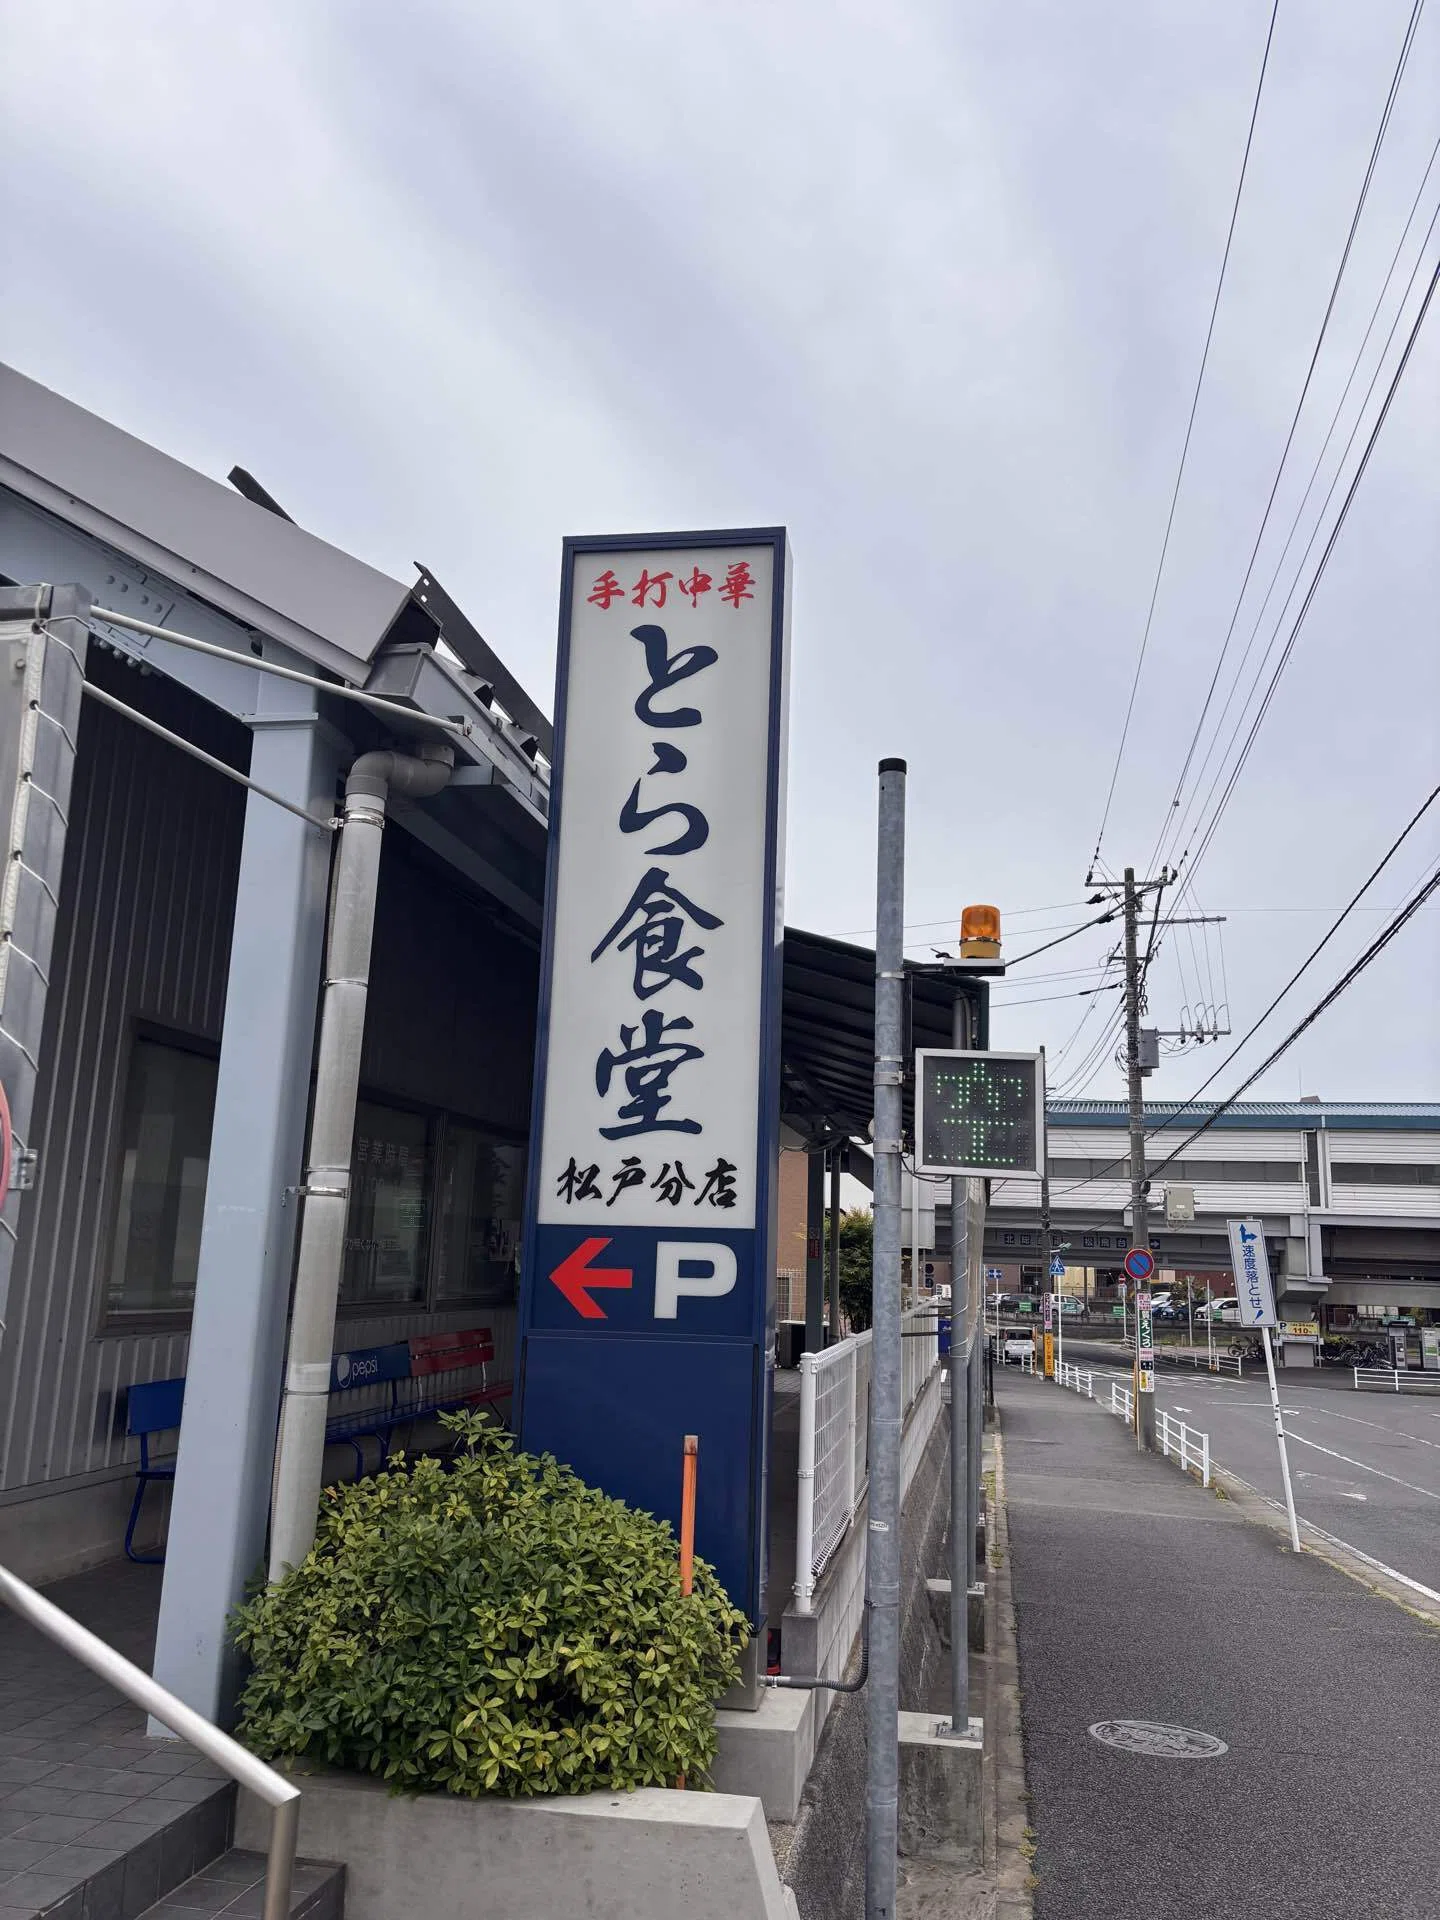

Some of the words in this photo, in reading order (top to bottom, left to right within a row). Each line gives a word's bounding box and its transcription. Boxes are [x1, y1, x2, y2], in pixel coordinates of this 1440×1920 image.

[587, 562, 756, 609] 手打中華
[591, 624, 725, 1141] とら食堂
[557, 1156, 738, 1208] 松戸分店
[654, 1241, 738, 1319] P
[352, 1355, 378, 1381] pepsi
